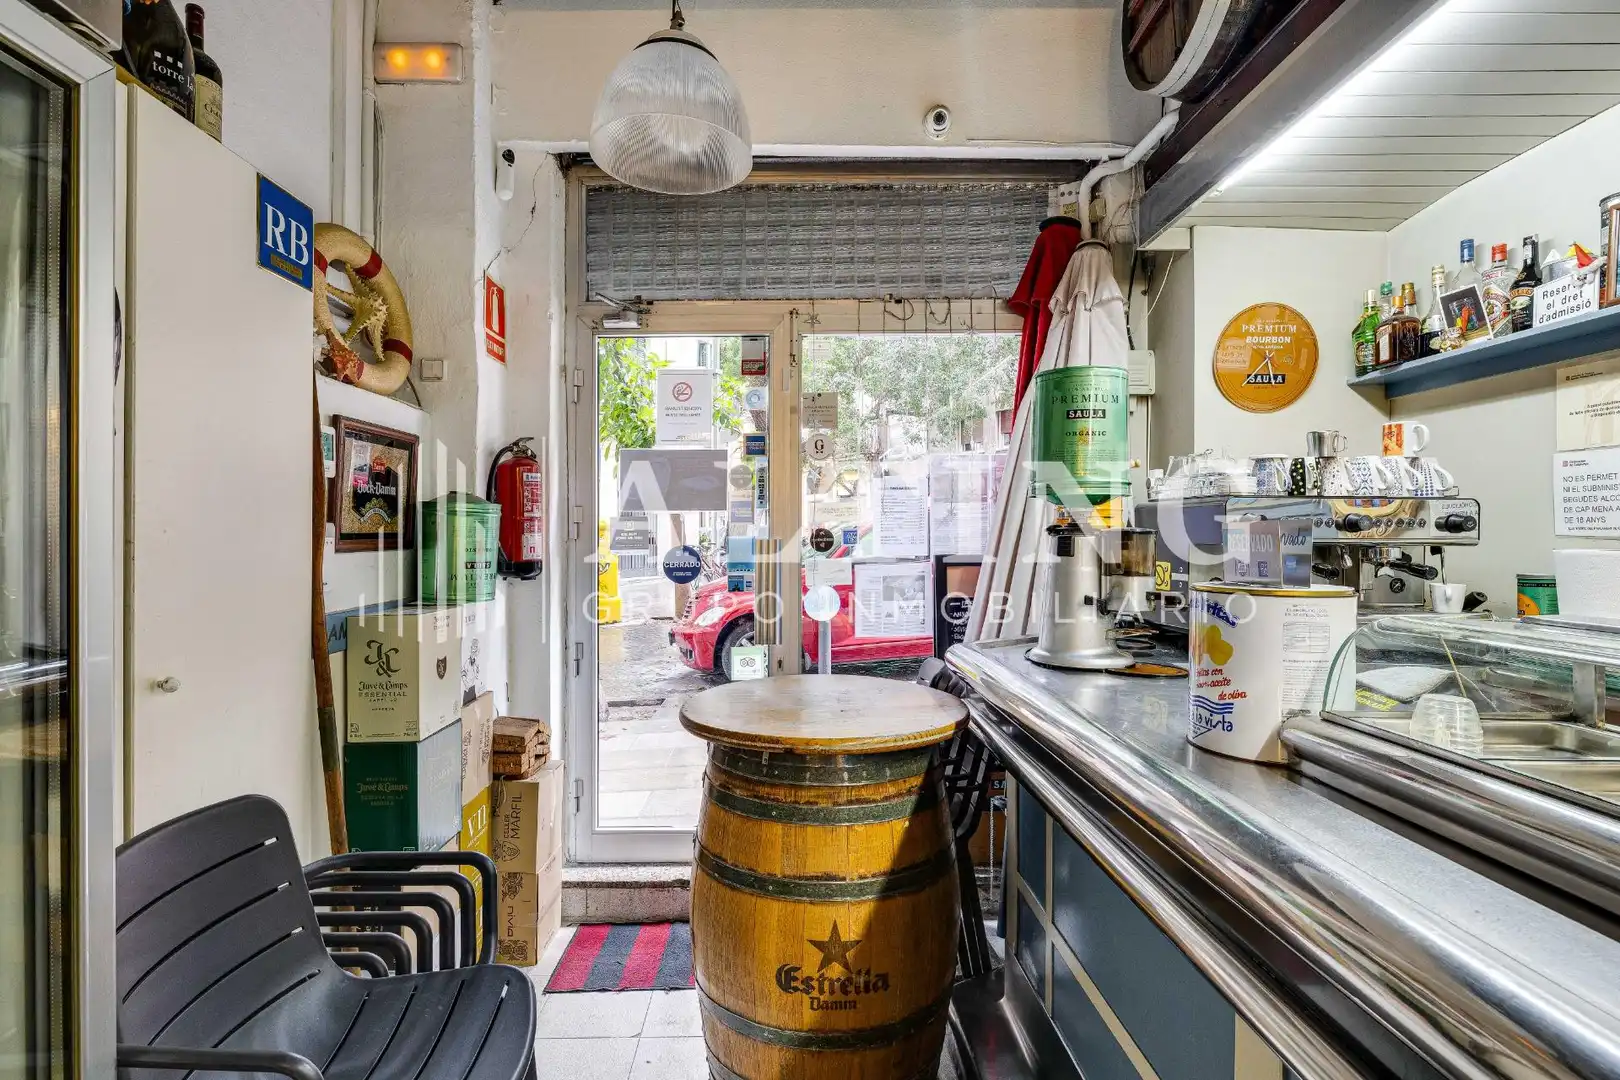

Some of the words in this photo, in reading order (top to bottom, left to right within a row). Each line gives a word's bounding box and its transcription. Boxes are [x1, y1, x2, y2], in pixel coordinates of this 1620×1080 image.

[152, 61, 185, 84] torre
[264, 202, 309, 266] RB
[1546, 301, 1555, 311] el
[1562, 292, 1583, 306] dret
[1538, 298, 1592, 325] d'admissió
[1241, 324, 1297, 333] PREMIUM
[1245, 335, 1291, 344] BOURBON
[1051, 394, 1120, 405] PREMIUM
[1068, 410, 1104, 418] SAULA
[1575, 474, 1585, 482] ES
[1587, 472, 1618, 481] PERMET
[1211, 668, 1224, 676] con
[1209, 677, 1232, 688] aceite
[1218, 690, 1227, 701] de
[1228, 689, 1248, 700] oliva
[1204, 713, 1233, 732] vista
[356, 783, 377, 794] Juvé
[384, 782, 409, 793] Camps
[510, 796, 522, 839] MARFIL
[775, 963, 890, 996] Estrella
[809, 996, 857, 1012] Damm
